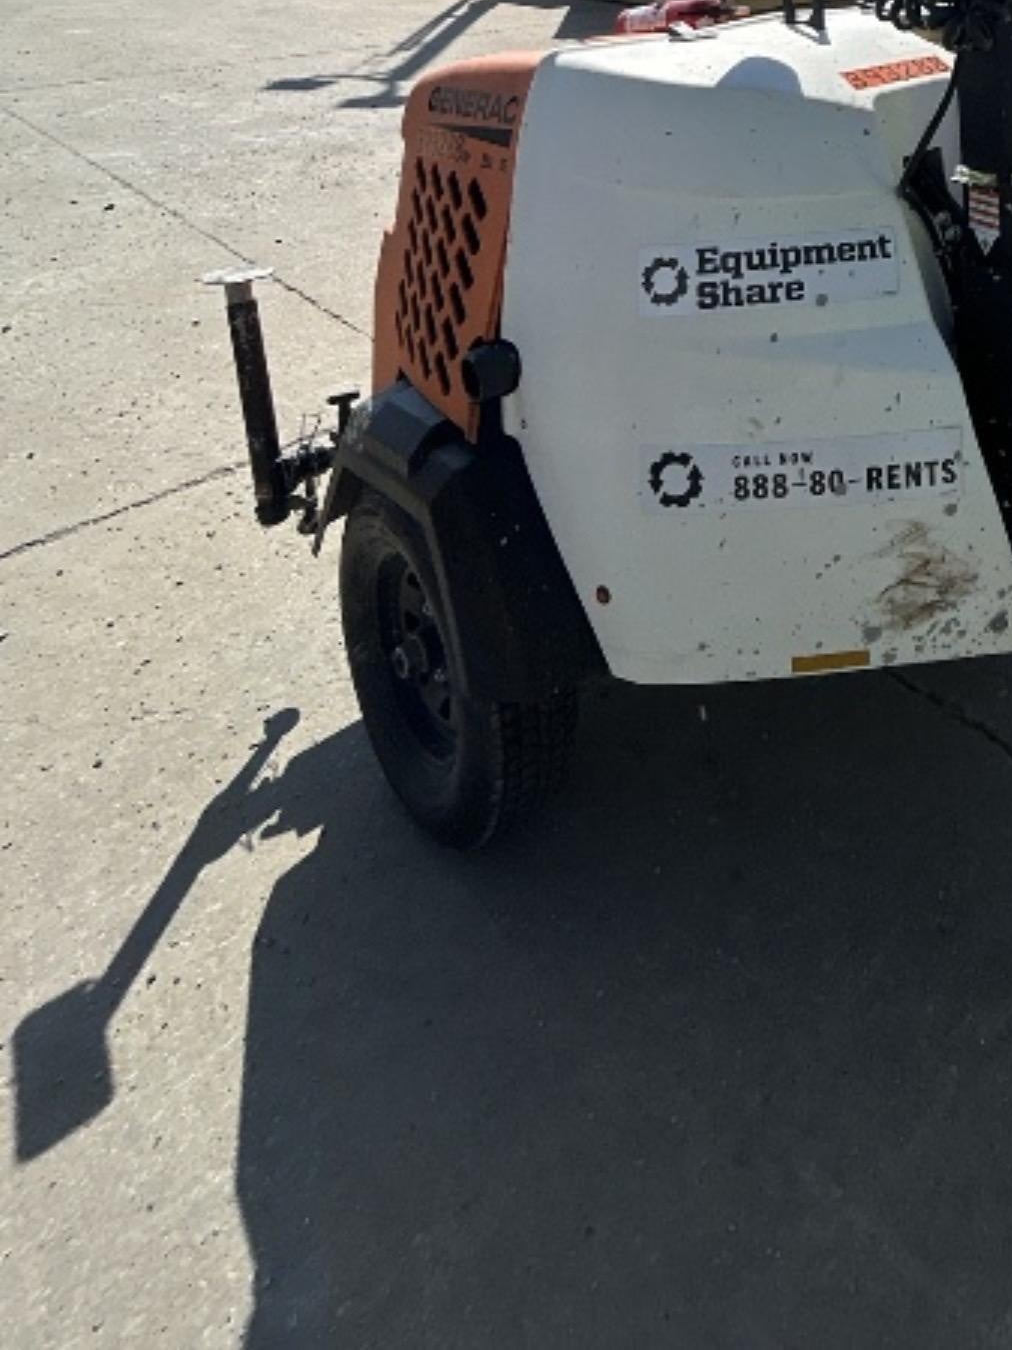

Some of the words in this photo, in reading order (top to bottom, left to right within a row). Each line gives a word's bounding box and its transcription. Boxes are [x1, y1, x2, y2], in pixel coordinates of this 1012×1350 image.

[428, 86, 520, 124] GENERAC
[695, 234, 892, 279] Equipment
[696, 278, 805, 310] Share
[732, 453, 772, 469] CALL
[779, 451, 814, 466] NOW
